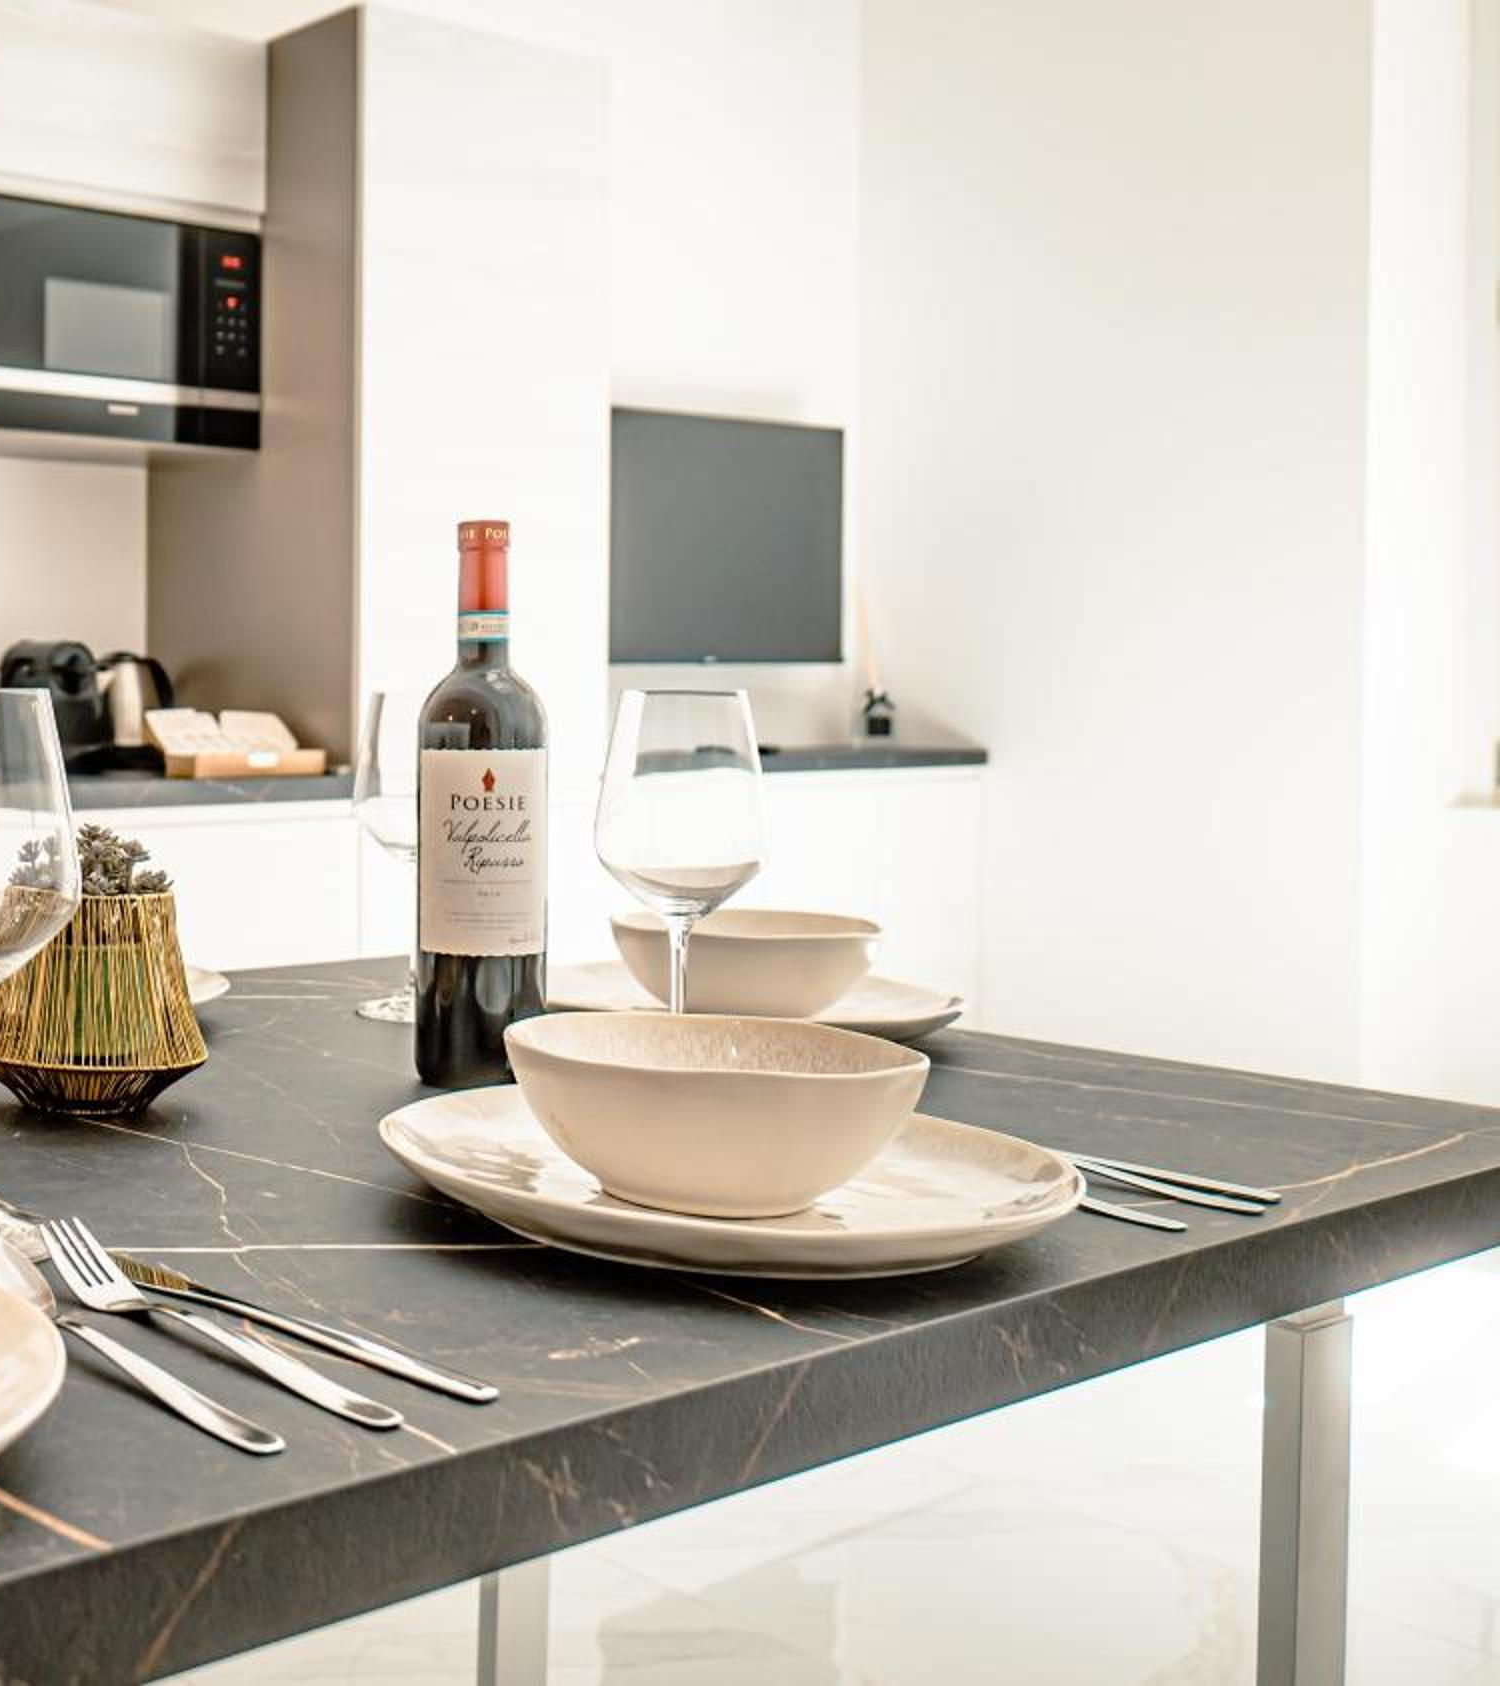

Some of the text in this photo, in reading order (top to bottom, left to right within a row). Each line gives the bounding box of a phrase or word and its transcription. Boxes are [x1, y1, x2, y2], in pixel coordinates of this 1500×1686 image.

[451, 794, 527, 811] POESIE
[443, 819, 531, 854] Valpolicella
[463, 846, 524, 875] Ripasso
